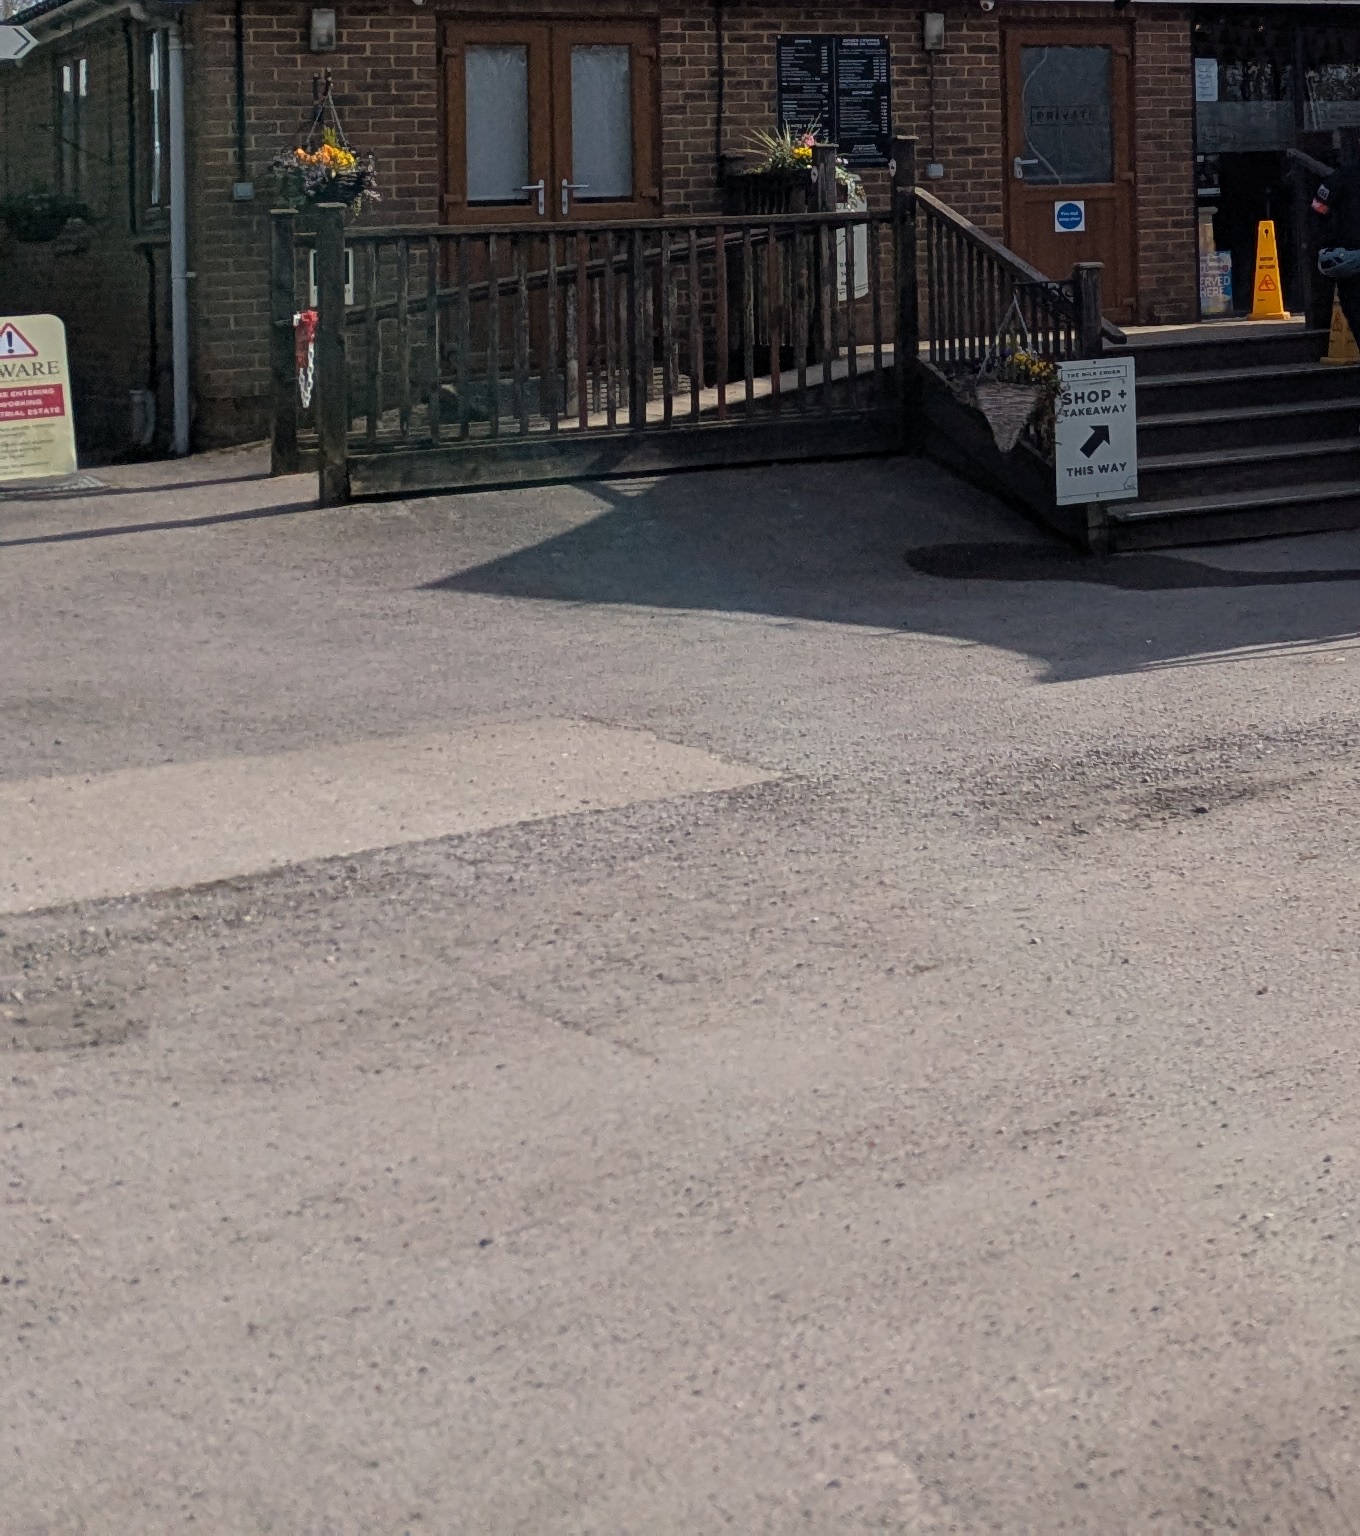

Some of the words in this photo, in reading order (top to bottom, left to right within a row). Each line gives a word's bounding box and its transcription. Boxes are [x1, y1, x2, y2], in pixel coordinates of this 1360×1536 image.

[1200, 275, 1231, 288] ERVED
[1062, 389, 1111, 406] SHOP
[1063, 403, 1128, 418] TAKEAWAY
[1065, 465, 1095, 478] THIS
[1097, 461, 1128, 475] WAY
